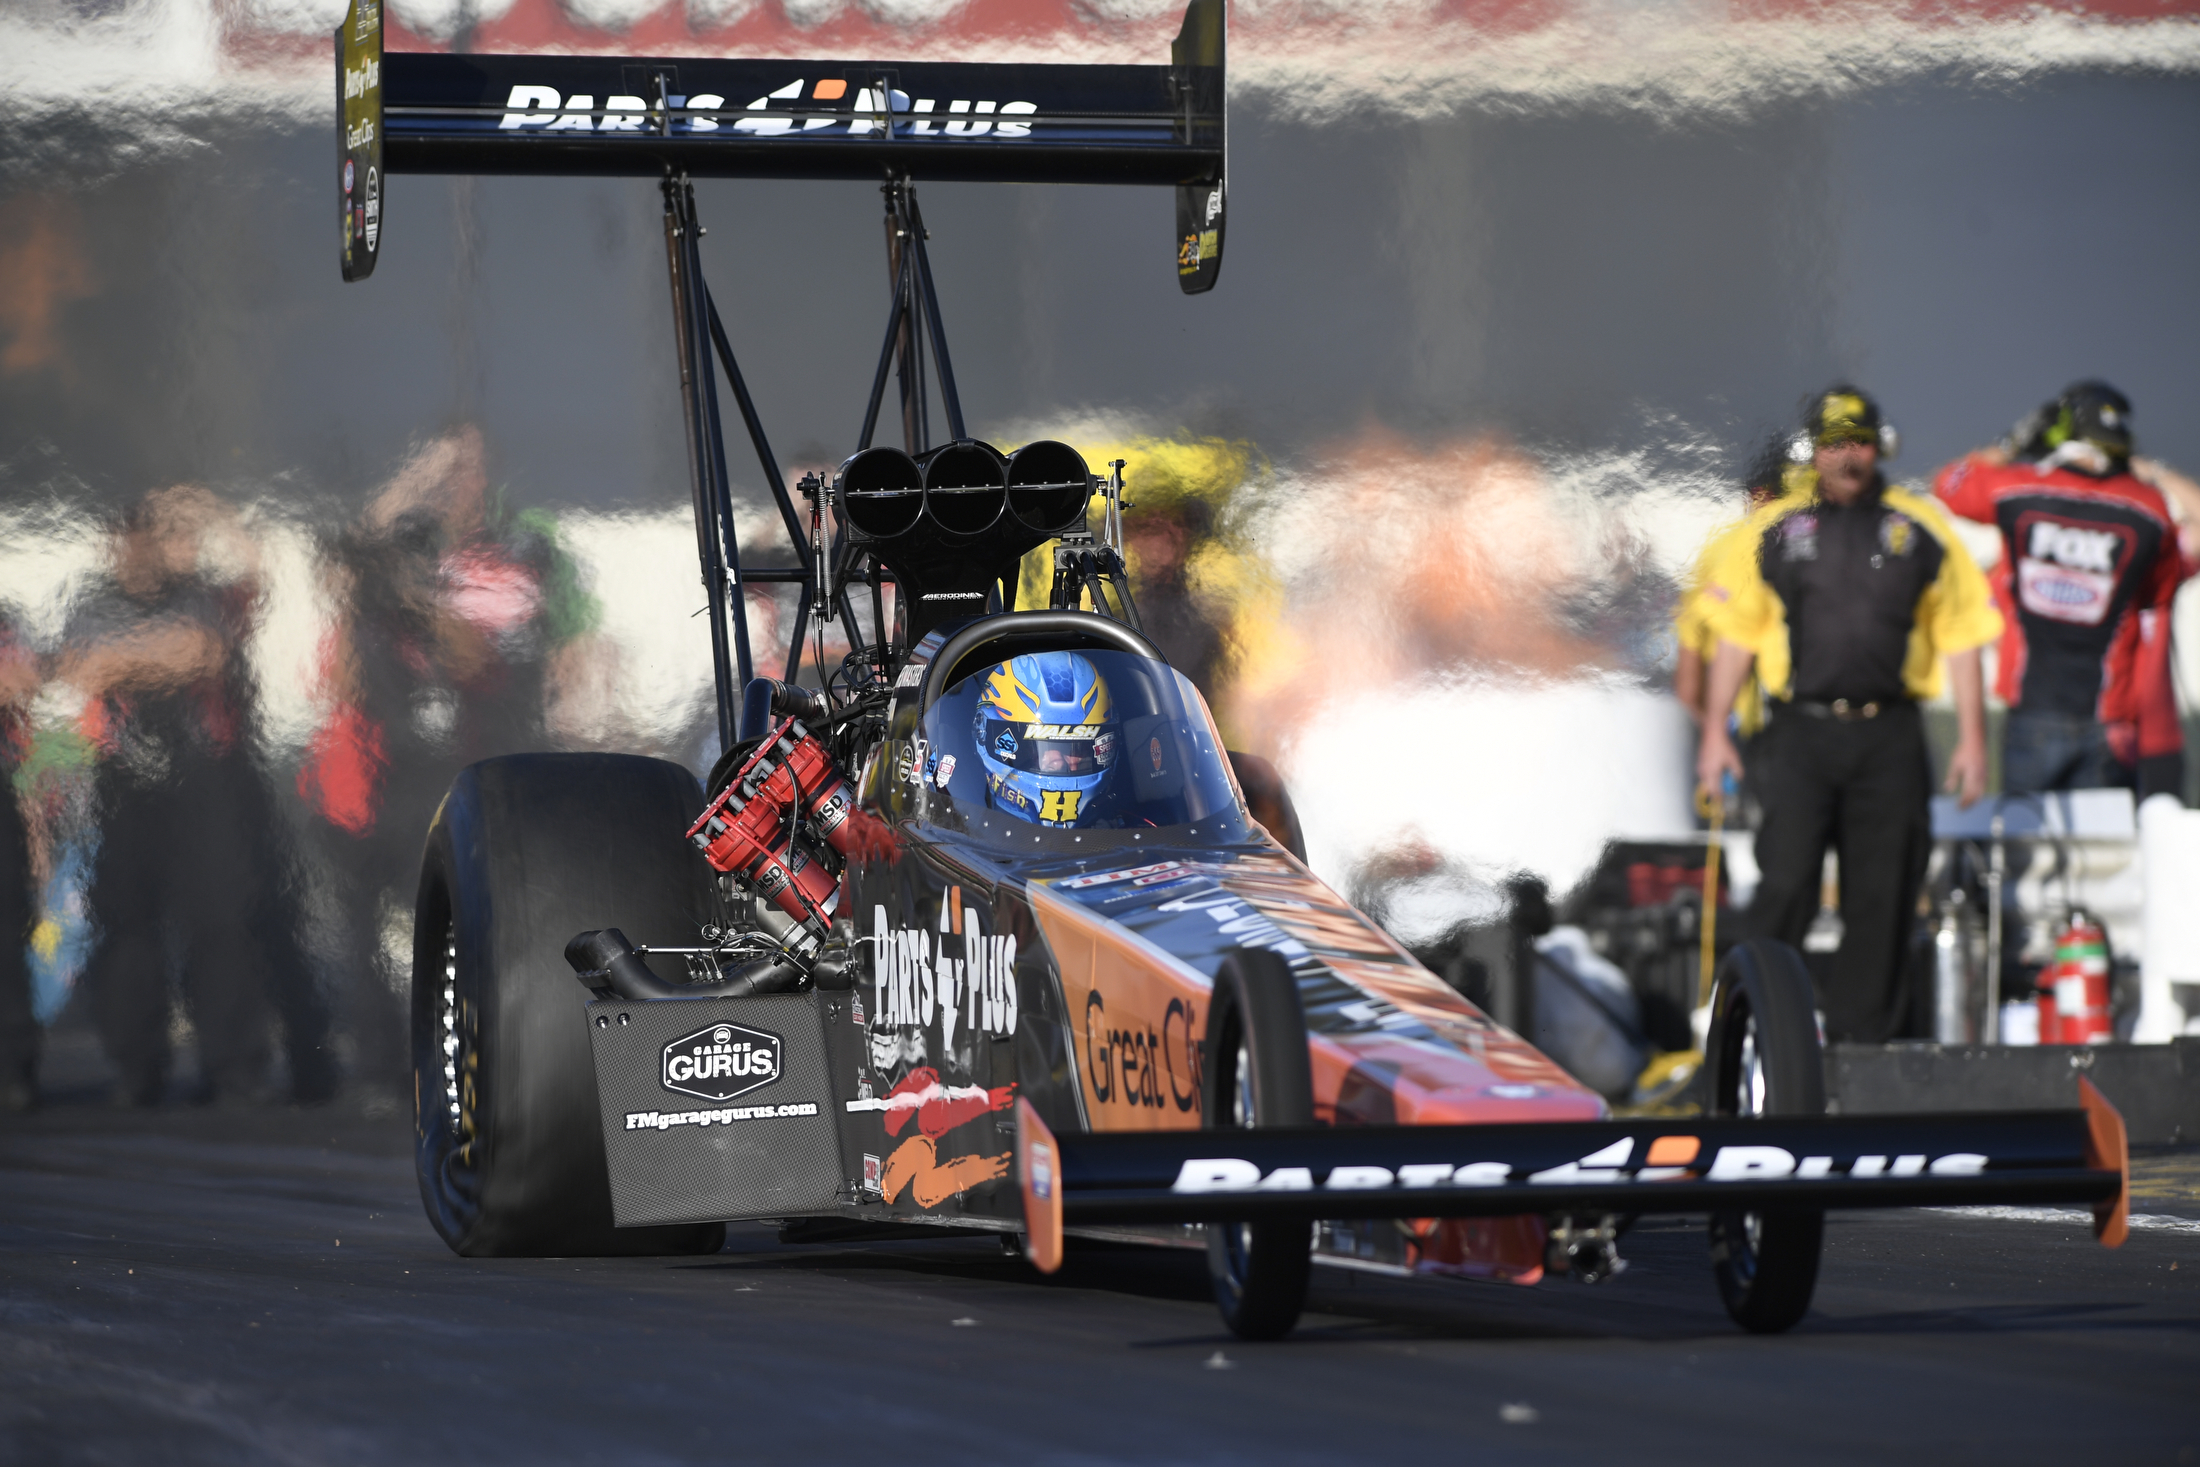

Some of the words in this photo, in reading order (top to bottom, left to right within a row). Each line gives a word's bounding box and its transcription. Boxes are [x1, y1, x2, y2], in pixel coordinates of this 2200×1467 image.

[2029, 521, 2117, 571] FOX
[1023, 724, 1100, 740] WALSH
[814, 794, 844, 829] MSD
[1039, 790, 1082, 822] H
[756, 865, 783, 892] MSD
[874, 904, 934, 1028] PARTS
[964, 907, 1018, 1036] PLUS
[668, 1048, 775, 1082] GURUS
[693, 1042, 752, 1057] GARAGE
[1086, 989, 1165, 1109] Great
[625, 1102, 818, 1130] FMgaragegurus.com
